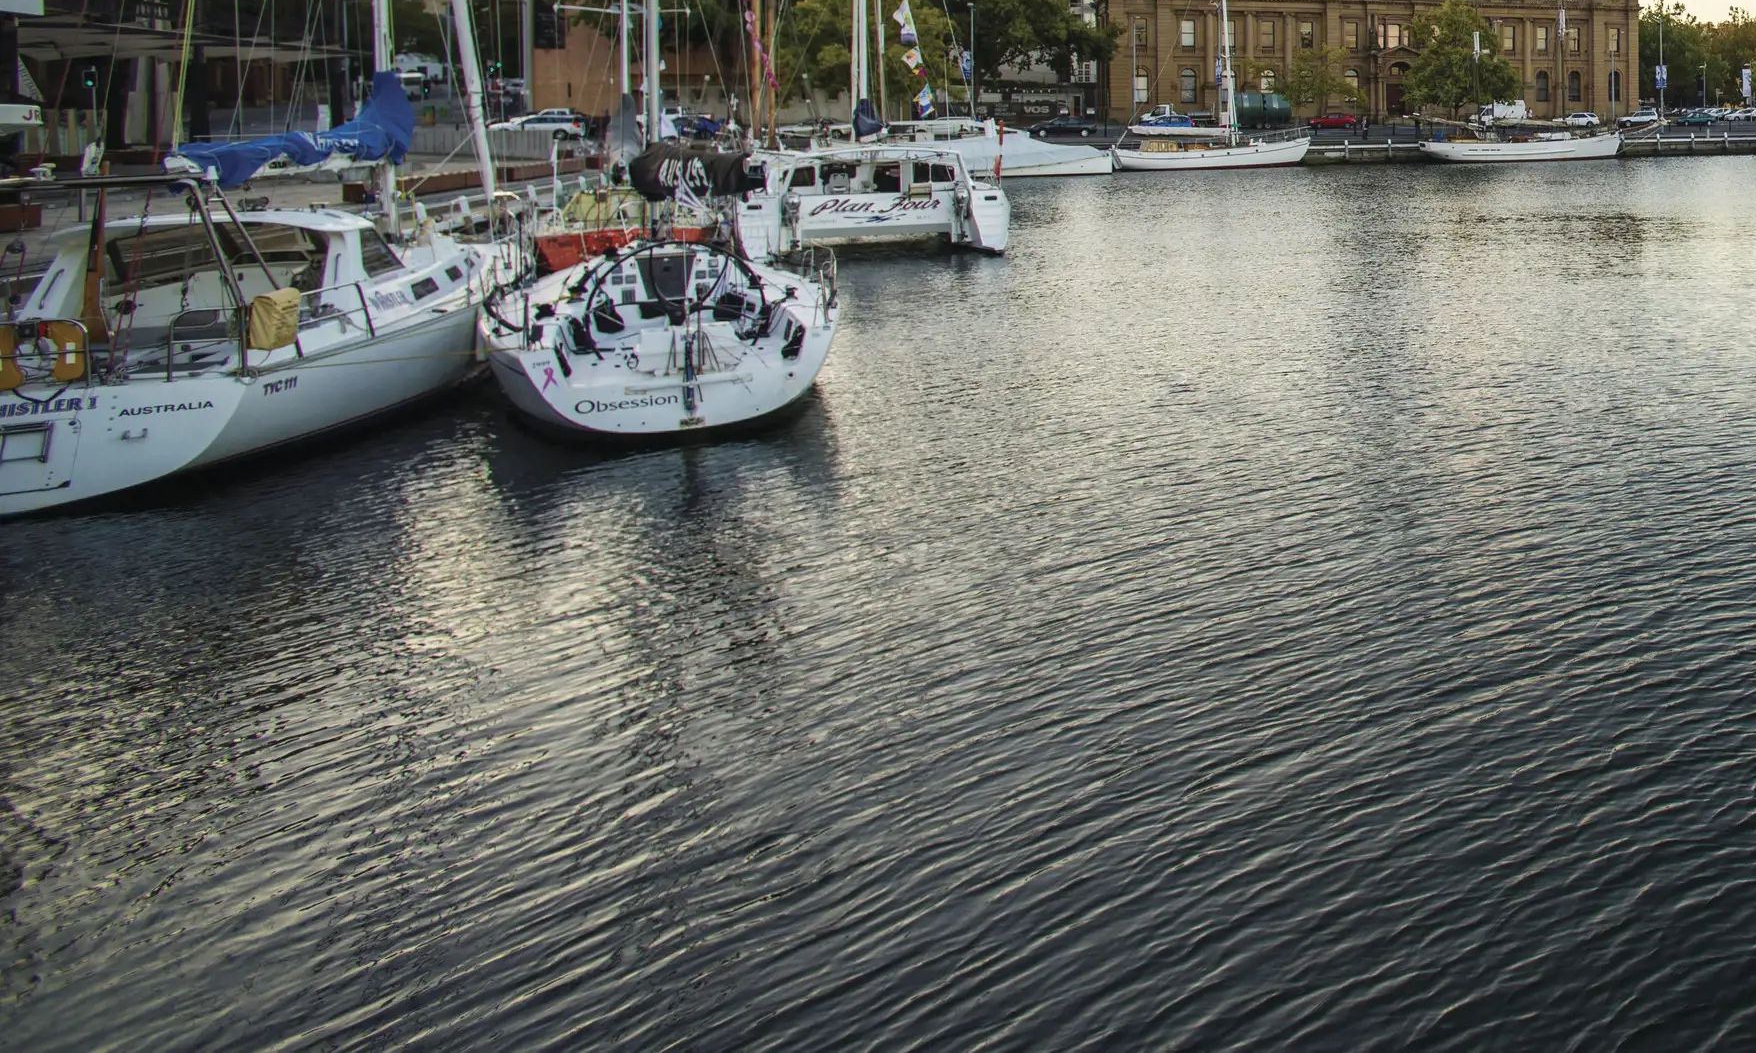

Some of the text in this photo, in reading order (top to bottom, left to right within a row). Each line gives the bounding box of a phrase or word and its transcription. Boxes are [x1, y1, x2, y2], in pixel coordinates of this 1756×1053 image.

[1023, 105, 1050, 114] VOS
[809, 196, 941, 216] Plan Four
[263, 380, 283, 396] TYC
[118, 400, 214, 417] AUSTRALIA
[575, 394, 679, 415] Obsession
